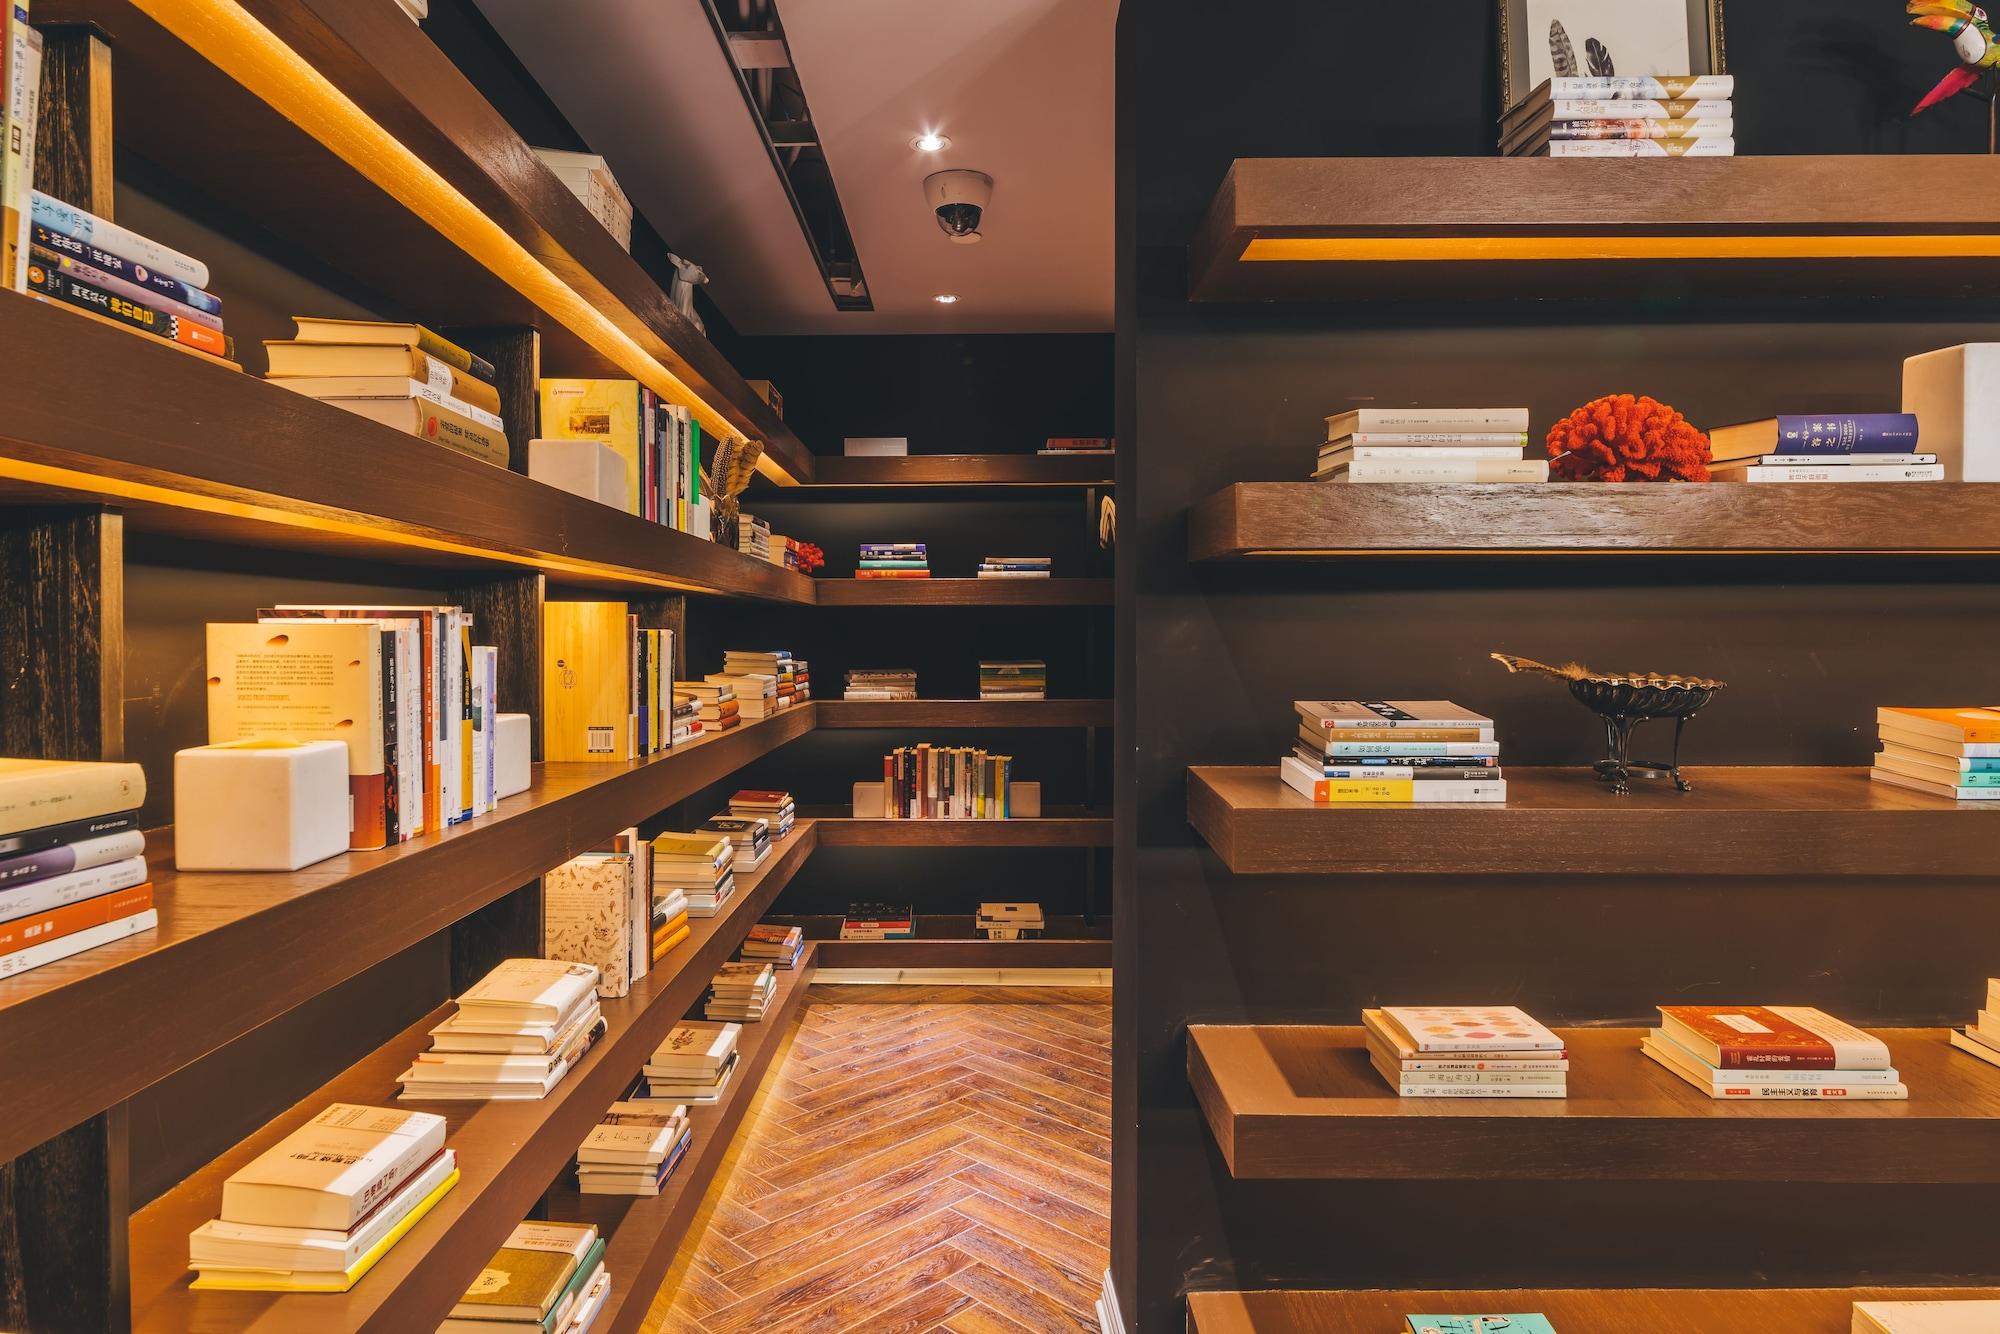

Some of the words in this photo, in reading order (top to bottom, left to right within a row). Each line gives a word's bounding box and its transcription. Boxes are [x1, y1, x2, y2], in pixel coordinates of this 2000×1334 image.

[71, 283, 109, 308] 阿西莫夫
[110, 297, 154, 326] 神们自己
[1810, 422, 1823, 448] 答案
[1826, 422, 1837, 447] 之书
[1358, 745, 1391, 753] 如何独处
[1746, 1055, 1791, 1063] 霍乱时期的爱情
[1761, 1087, 1818, 1097] 民主主义与教育
[289, 1153, 357, 1165] 巴黎烧了吗？
[363, 1167, 398, 1203] 巴黎烧了吗？
